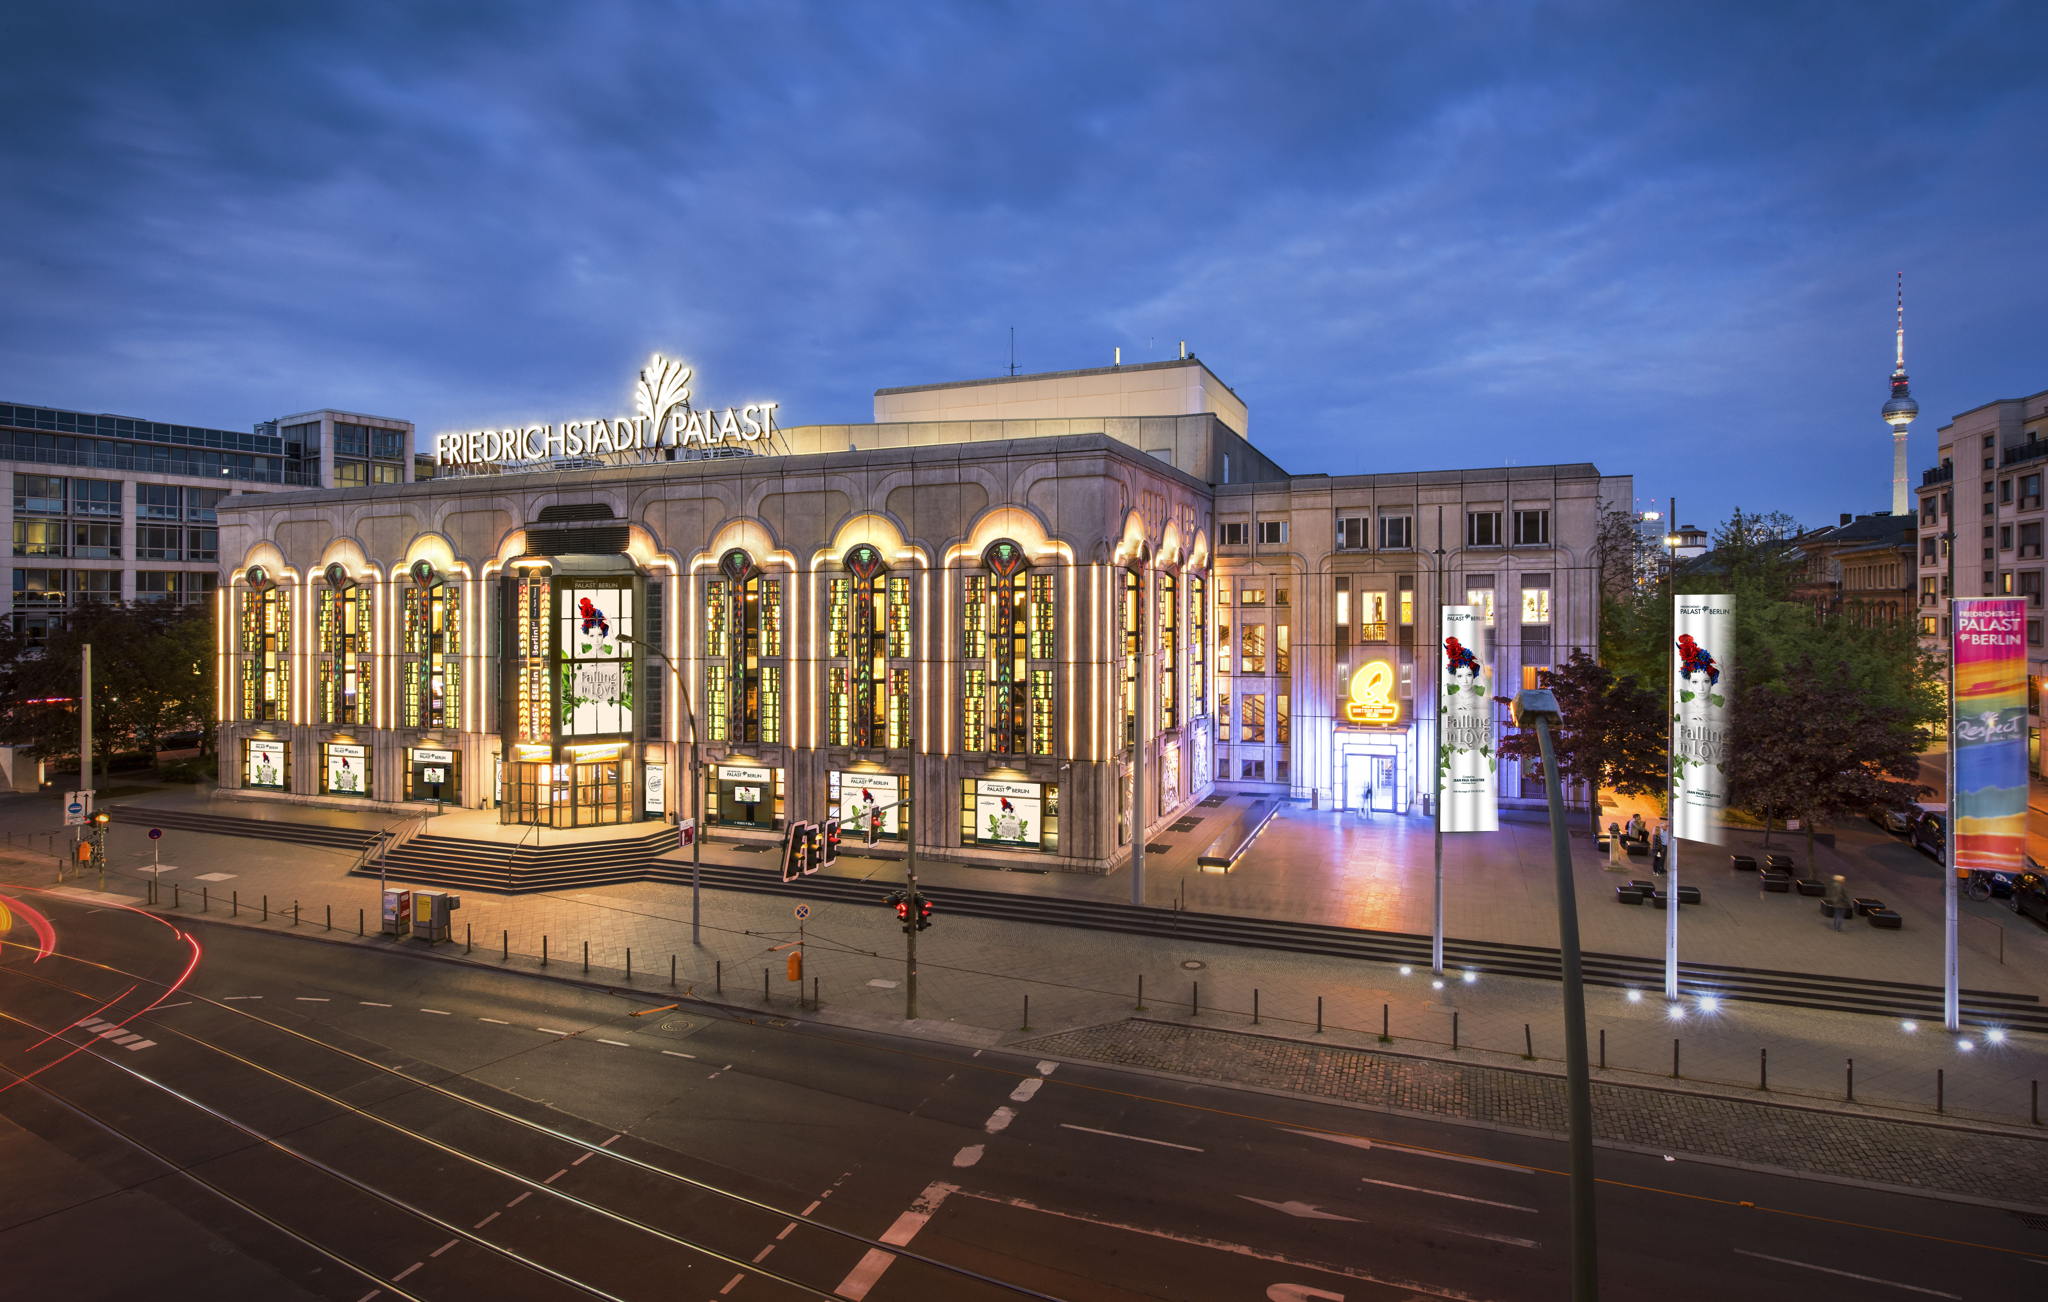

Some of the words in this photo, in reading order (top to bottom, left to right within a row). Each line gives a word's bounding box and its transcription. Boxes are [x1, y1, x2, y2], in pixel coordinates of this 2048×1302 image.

[437, 416, 649, 465] FRIEDRICHSTADT
[672, 403, 779, 447] PALAST
[1959, 618, 2021, 631] PALAST
[1971, 634, 2021, 646] BERLIN
[581, 671, 617, 685] Falling
[581, 684, 591, 695] in
[1446, 714, 1490, 732] Falling
